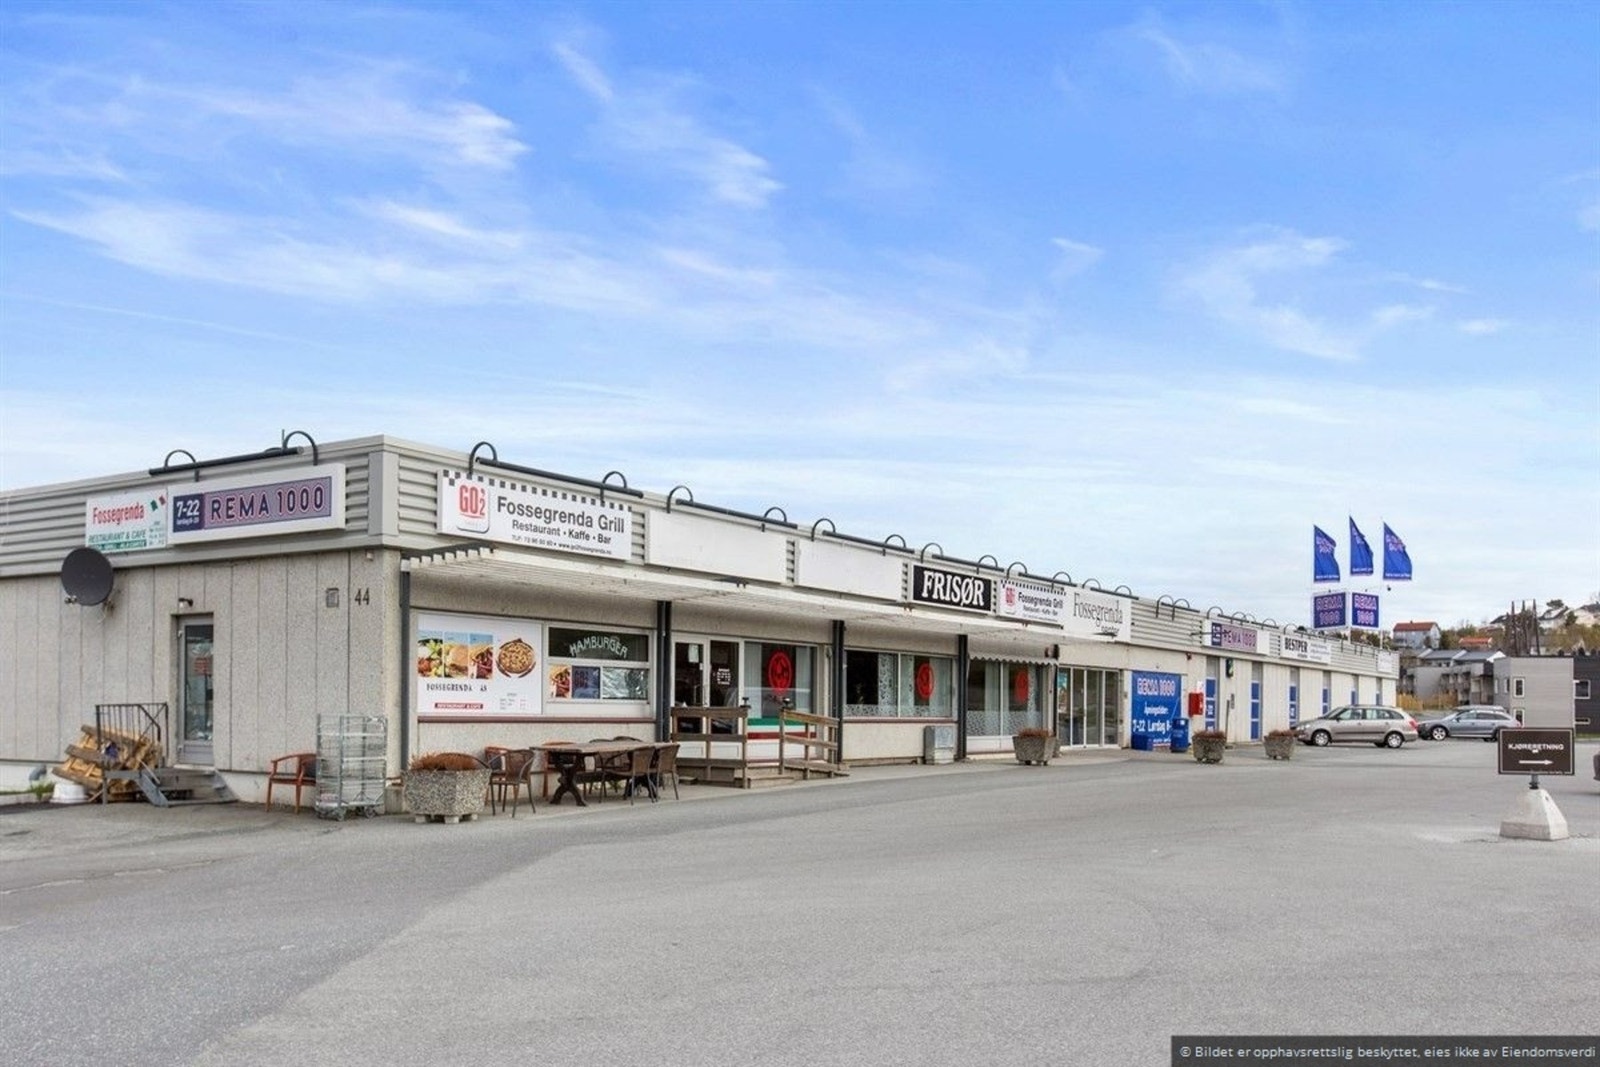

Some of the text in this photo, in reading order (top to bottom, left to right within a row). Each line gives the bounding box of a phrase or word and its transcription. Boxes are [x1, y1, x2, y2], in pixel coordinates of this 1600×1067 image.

[93, 502, 145, 525] Fossegrenda
[176, 499, 200, 517] 7-22
[210, 484, 325, 521] REMA 1000
[497, 496, 625, 534] Fossegrenda Grill
[512, 519, 612, 544] Restaurant Kaffe Bar
[354, 587, 370, 606] 44
[922, 570, 984, 607] FRISØR
[1018, 591, 1052, 607] Fossegrenda
[1073, 592, 1123, 627] Fossegrenda
[1354, 594, 1377, 610] REMA
[569, 635, 628, 659] HAMBURGER
[426, 683, 473, 692] FOSSEGRENDA
[1159, 679, 1176, 697] 1000
